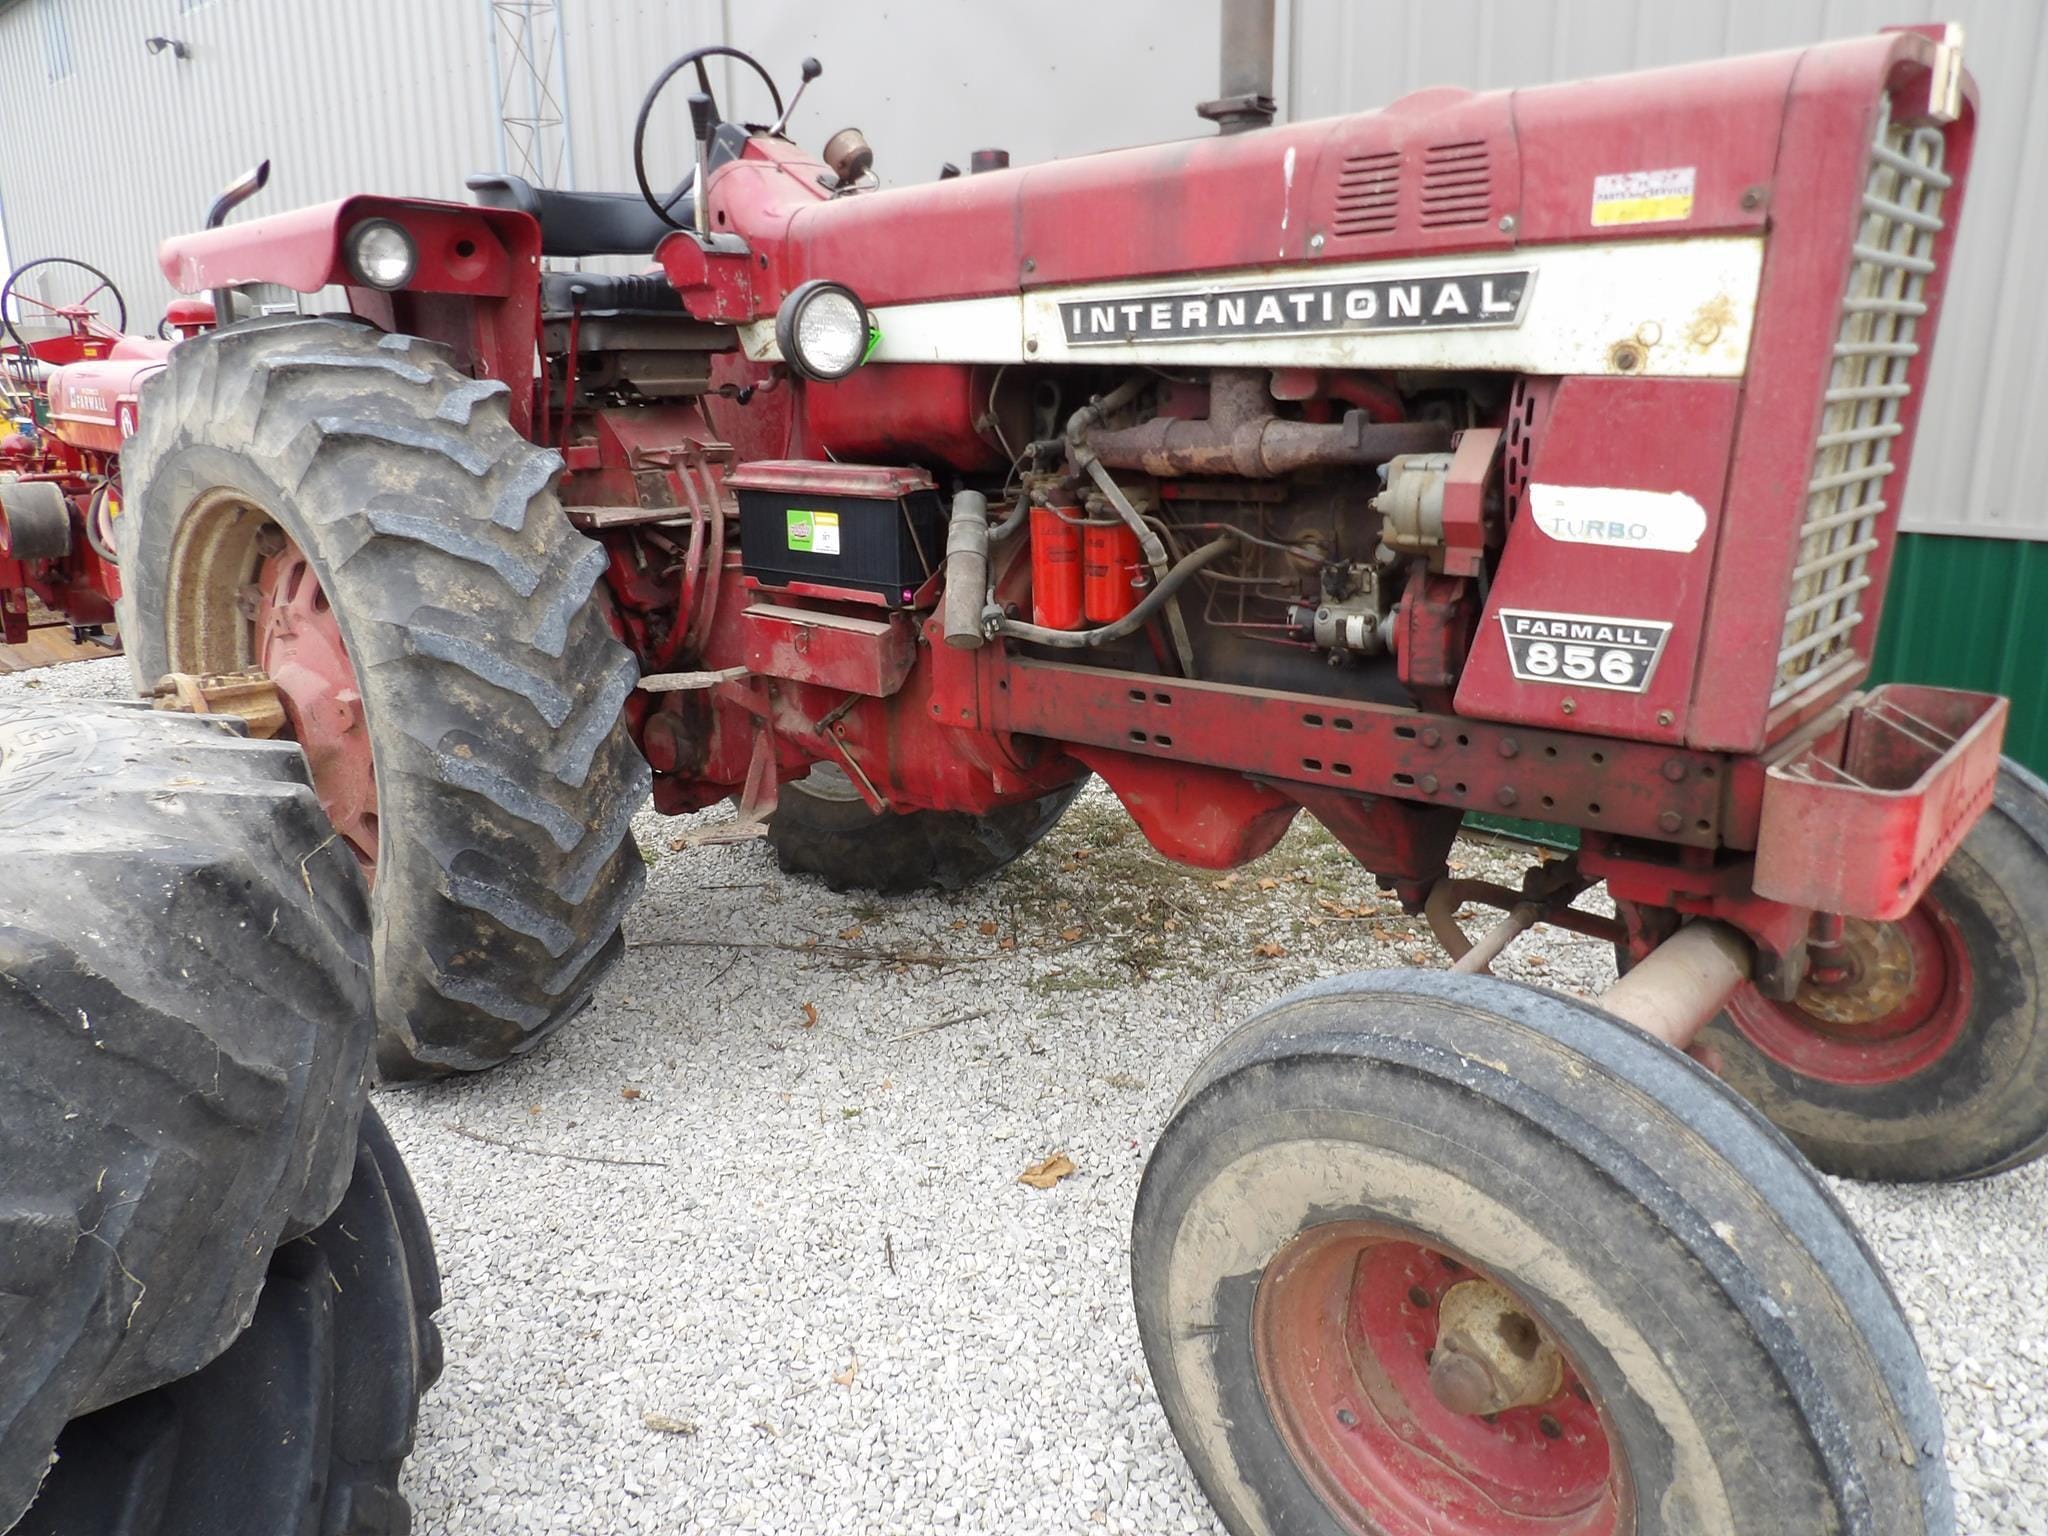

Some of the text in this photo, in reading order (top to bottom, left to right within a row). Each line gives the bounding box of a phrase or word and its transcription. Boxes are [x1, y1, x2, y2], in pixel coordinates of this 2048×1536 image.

[1072, 279, 1512, 335] INTERNATIONAL
[1551, 518, 1648, 540] TURBO
[1516, 618, 1648, 645] FARMALL
[1525, 642, 1634, 684] 856
